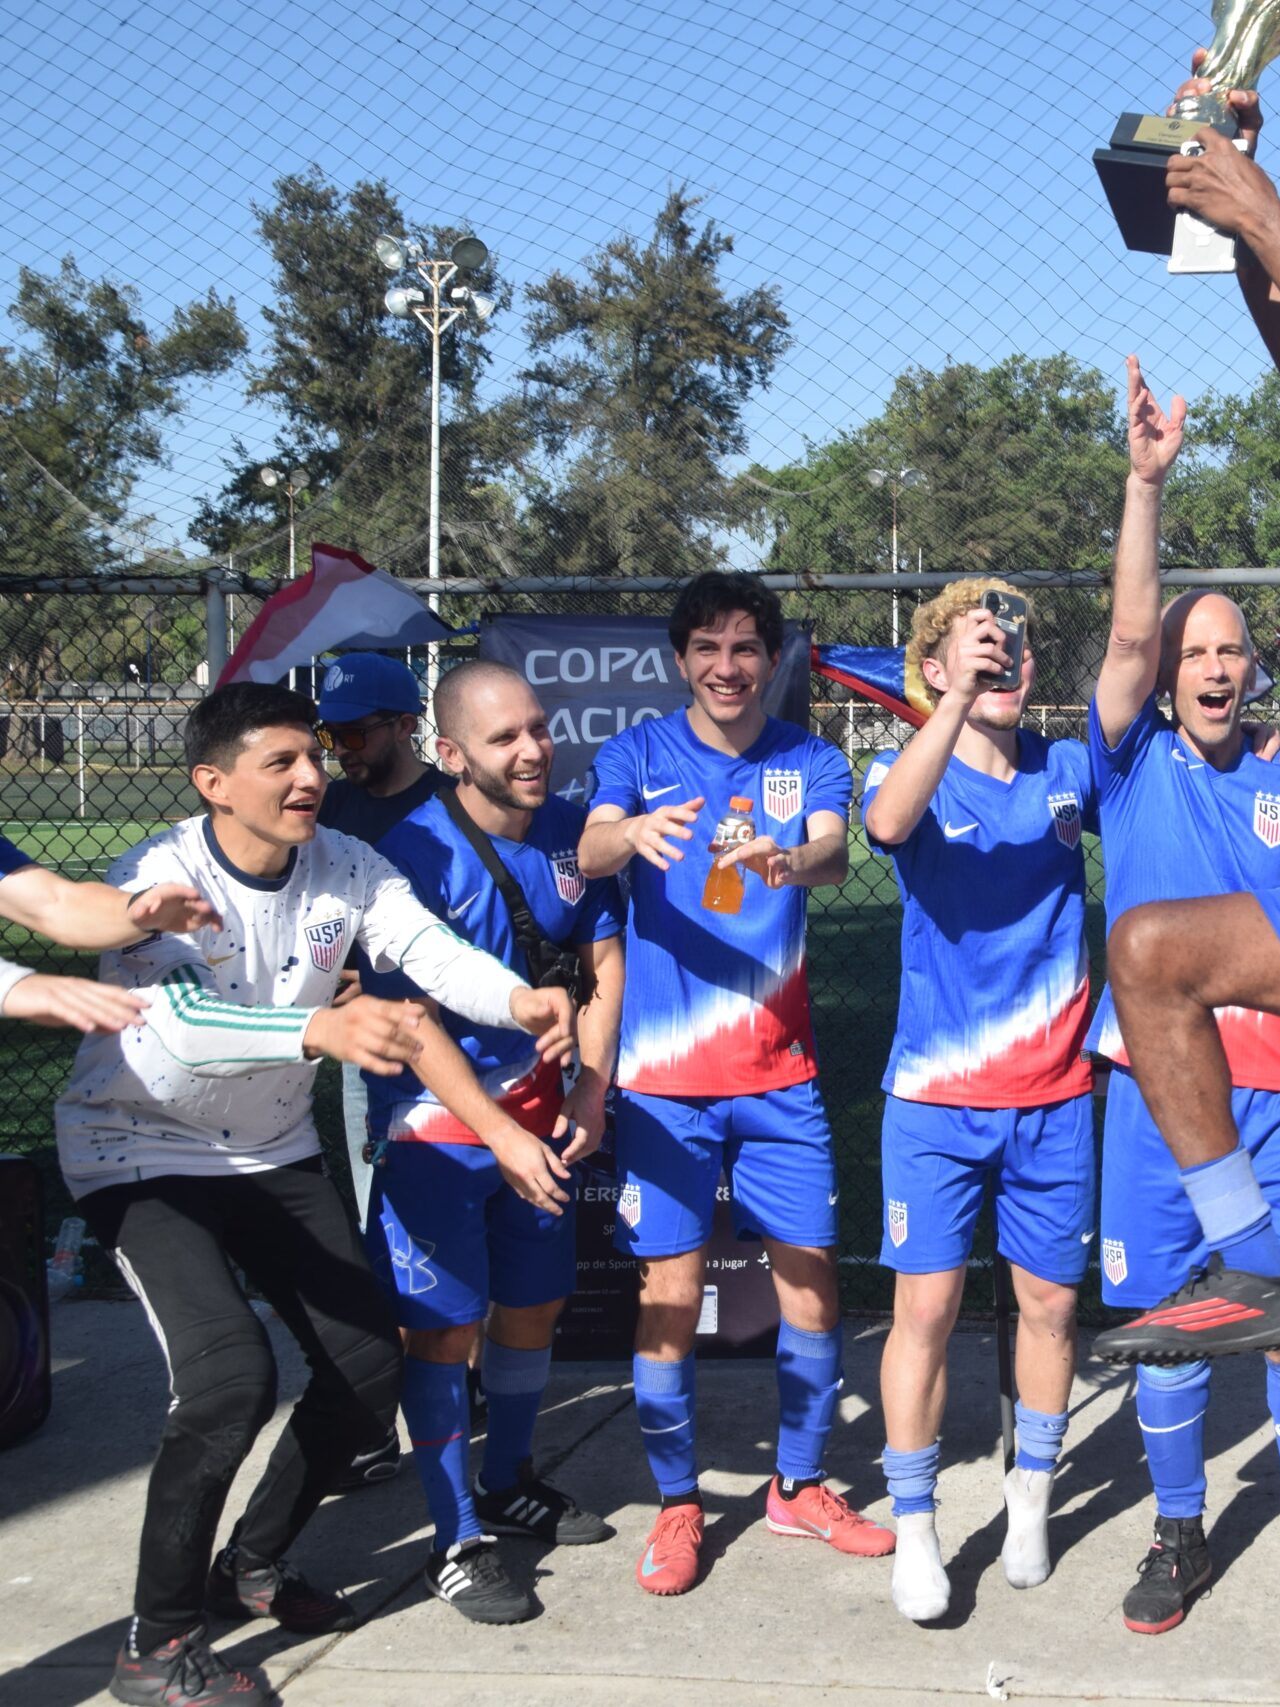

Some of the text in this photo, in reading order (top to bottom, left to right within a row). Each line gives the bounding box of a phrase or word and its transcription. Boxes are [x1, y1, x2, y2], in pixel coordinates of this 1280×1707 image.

[525, 647, 669, 685] COPA
[768, 780, 798, 796] USA
[1053, 803, 1078, 822] USA
[309, 921, 343, 945] USA
[721, 1258, 748, 1270] jugar
